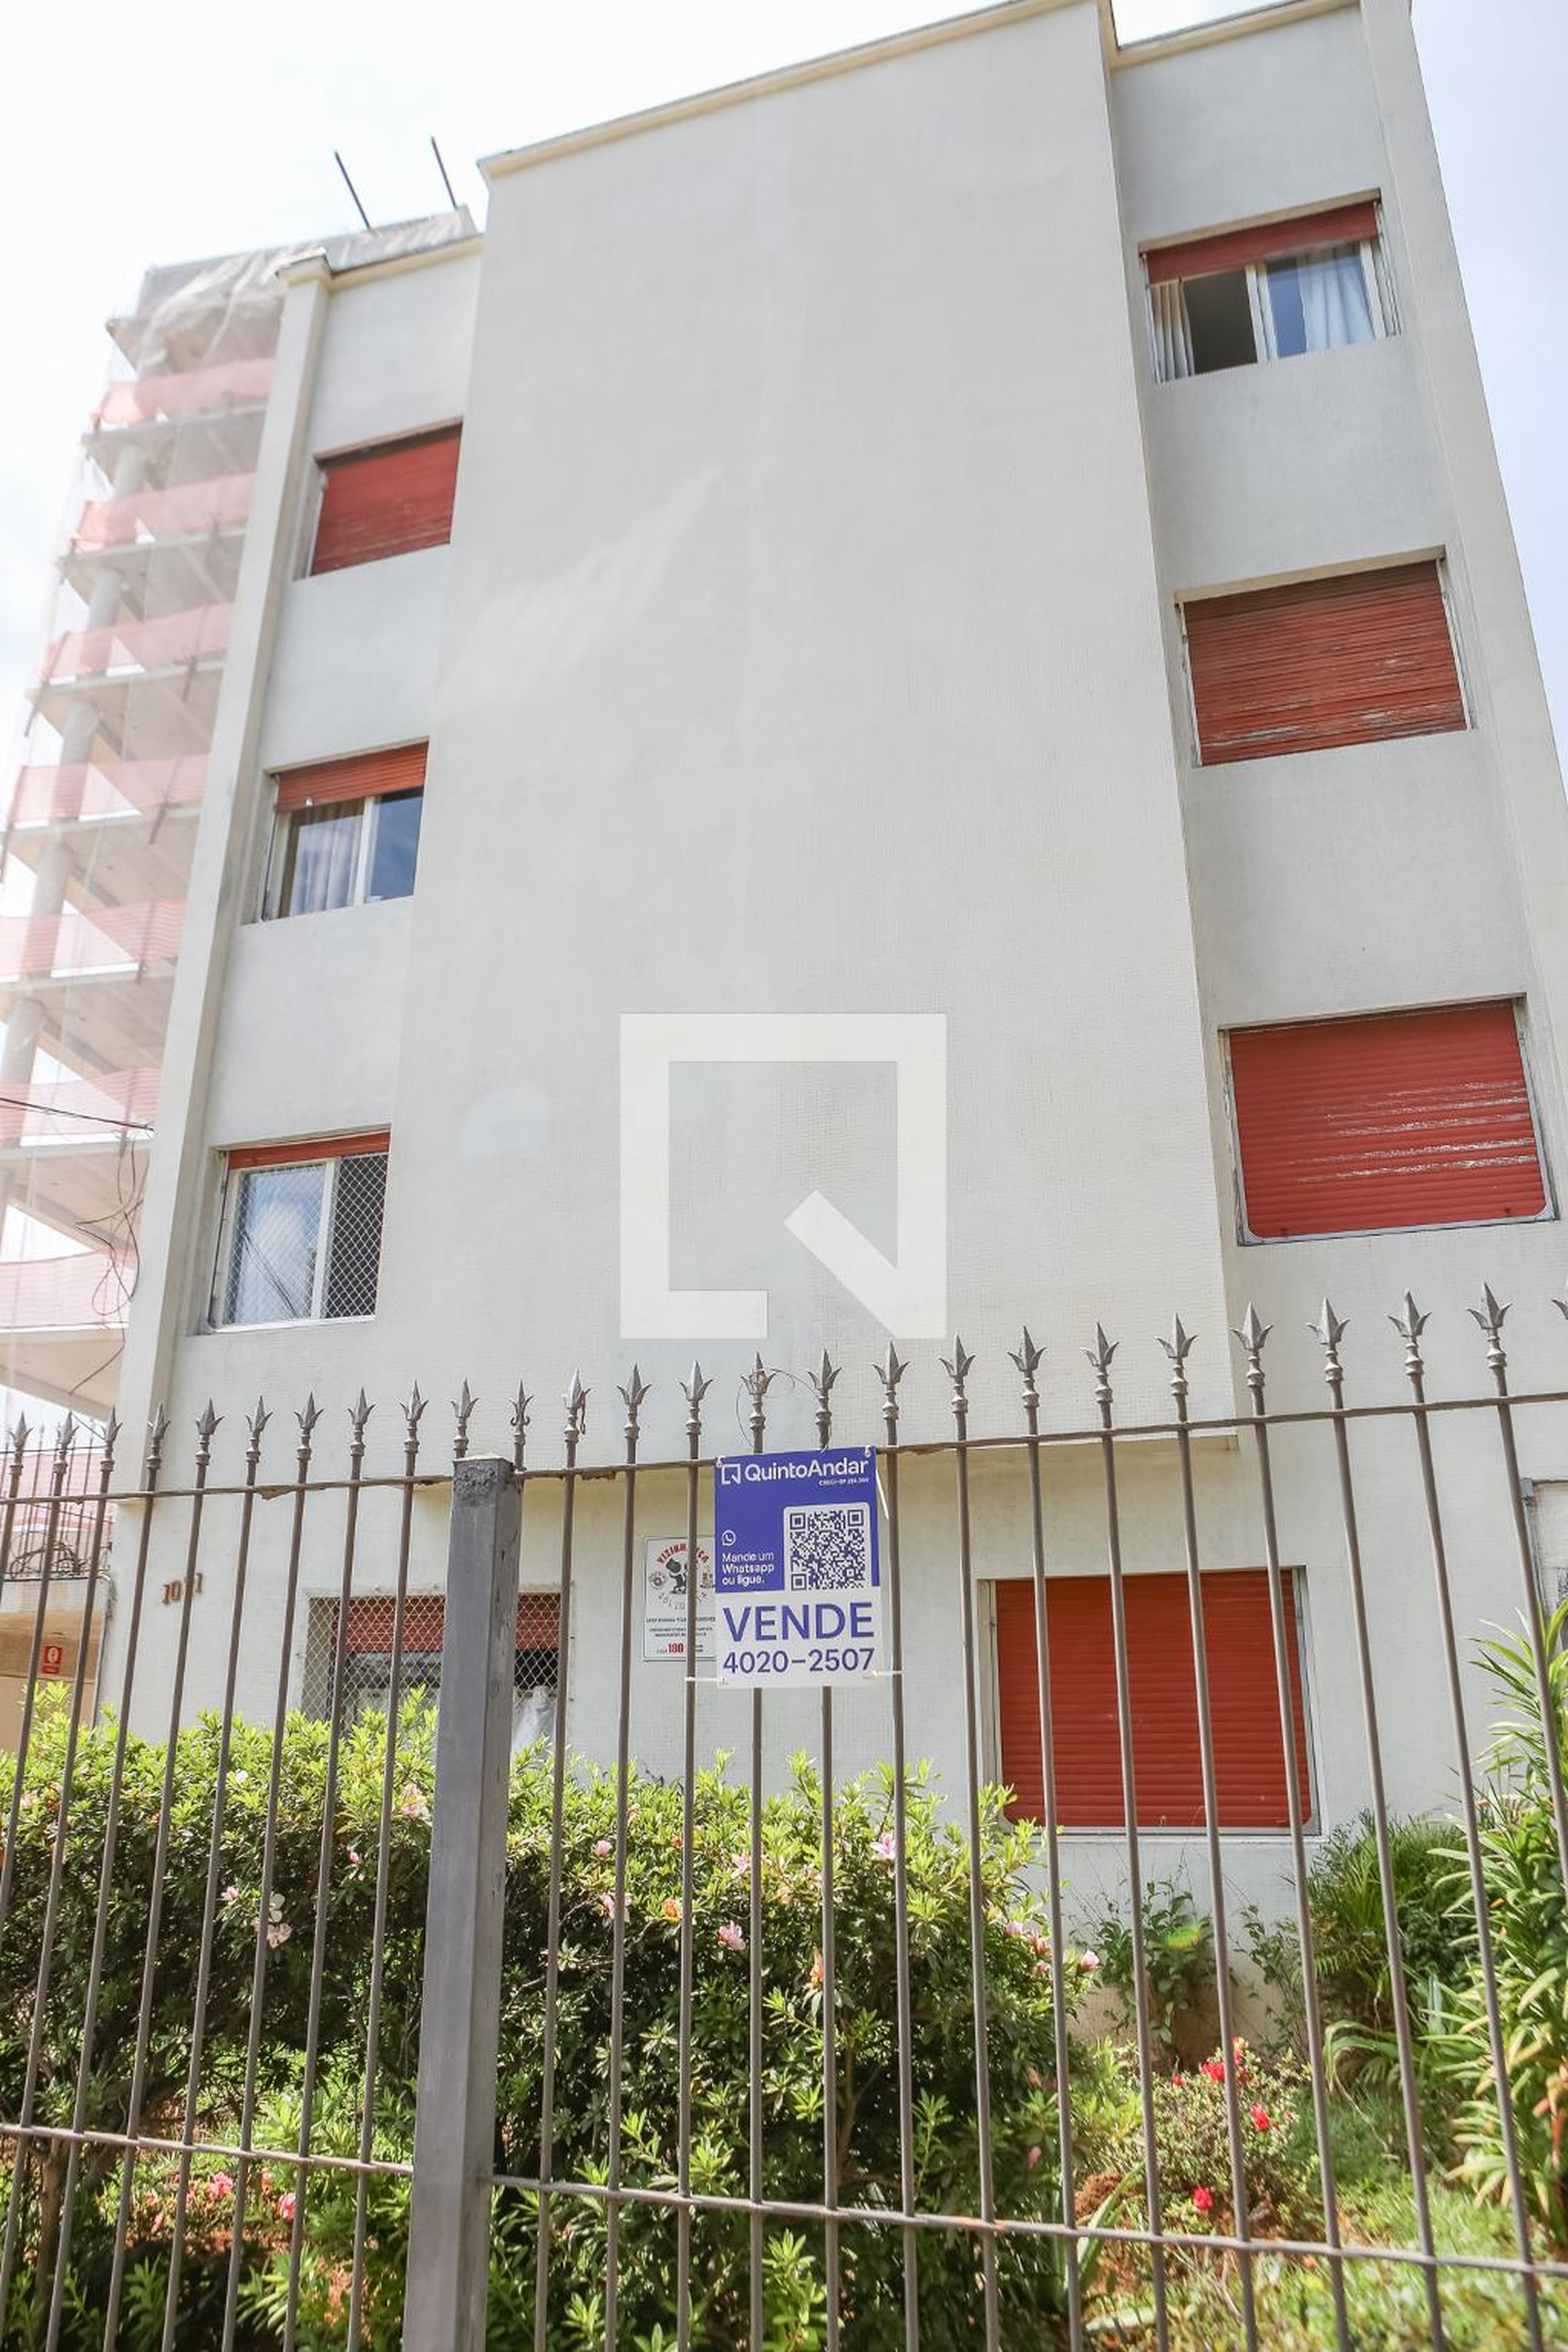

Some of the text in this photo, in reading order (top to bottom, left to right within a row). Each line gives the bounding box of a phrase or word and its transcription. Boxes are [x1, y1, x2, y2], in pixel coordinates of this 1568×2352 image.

[744, 1457, 869, 1482] QuintoAndar
[722, 1563, 775, 1574] Whatsapp
[759, 1552, 774, 1561] um
[162, 1572, 203, 1605] 101
[722, 1577, 735, 1585] ou
[722, 1602, 875, 1642] VENDE
[723, 1647, 875, 1674] 4020-2507
